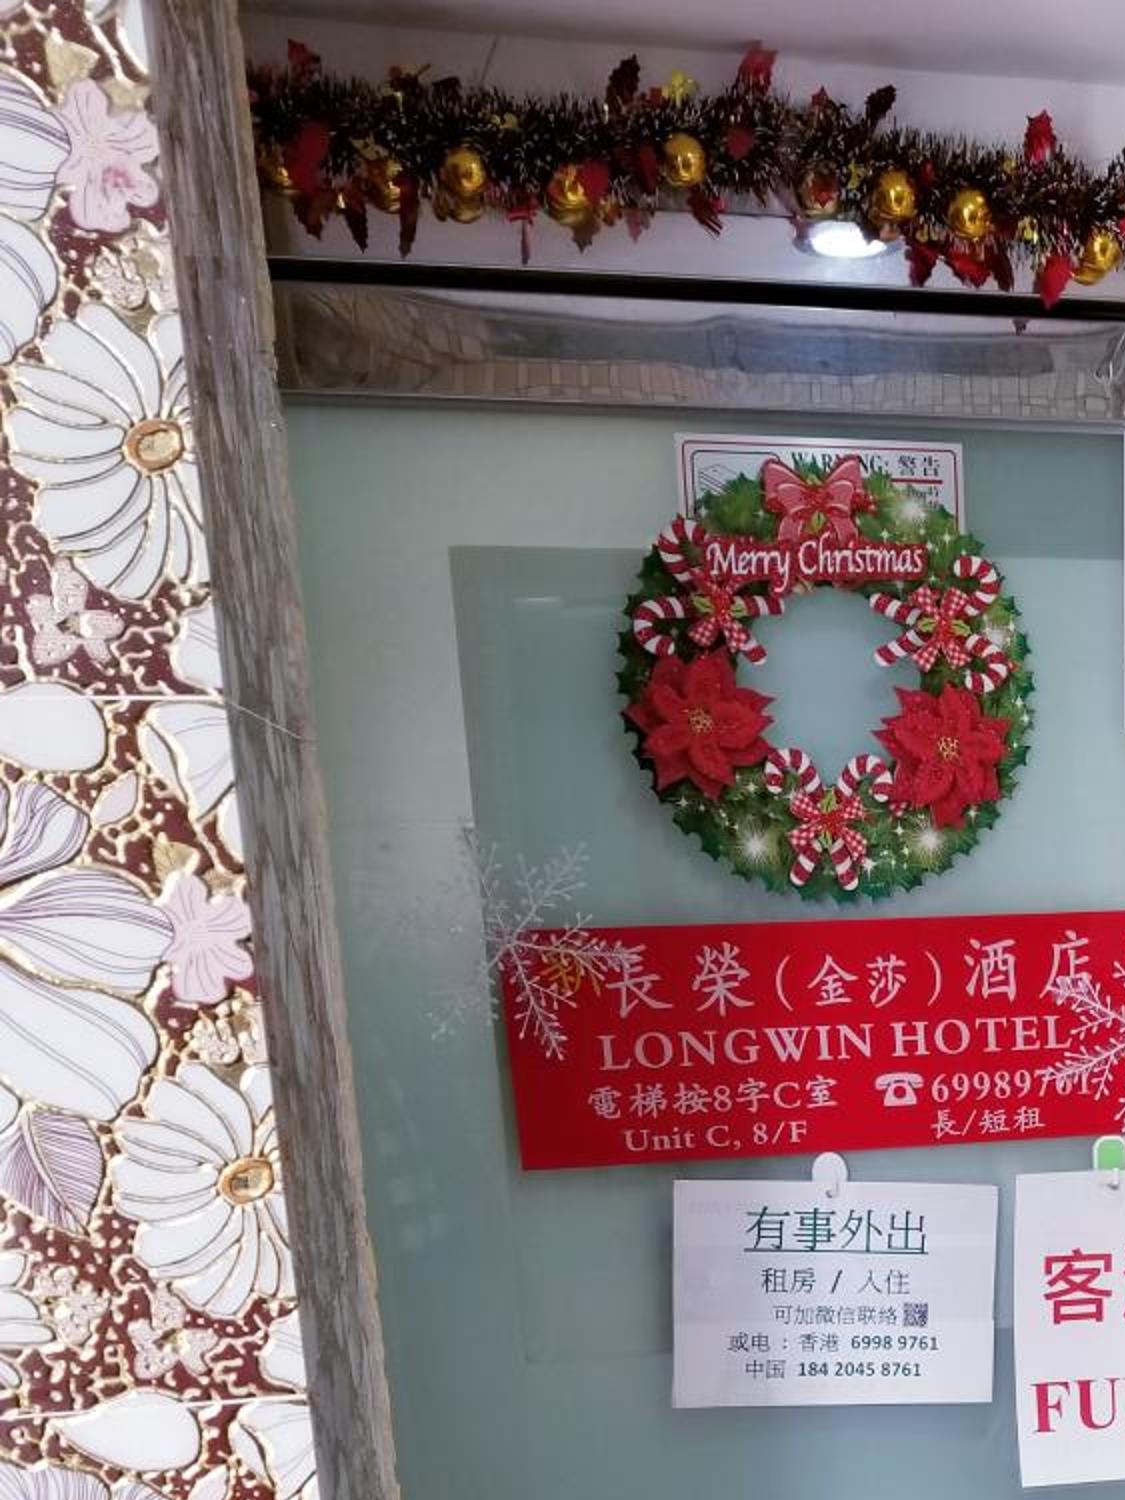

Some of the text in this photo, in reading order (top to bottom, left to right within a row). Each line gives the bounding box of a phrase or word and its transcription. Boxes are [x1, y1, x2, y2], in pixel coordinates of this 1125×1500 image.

[706, 531, 923, 590] Merry Christmas
[597, 1015, 1073, 1070] LONGWIN HOTEL
[624, 1119, 808, 1151] Unit C, 8/F
[931, 1105, 1046, 1139] 長/短租
[745, 1205, 928, 1254] 有事外出
[761, 1267, 817, 1295] 租房
[857, 1268, 911, 1296] 入住
[772, 1304, 898, 1326] 可加微信联络
[851, 1335, 893, 1351] 6998
[897, 1336, 939, 1351] 9761
[745, 1358, 922, 1380] 中国 184 2045 8761
